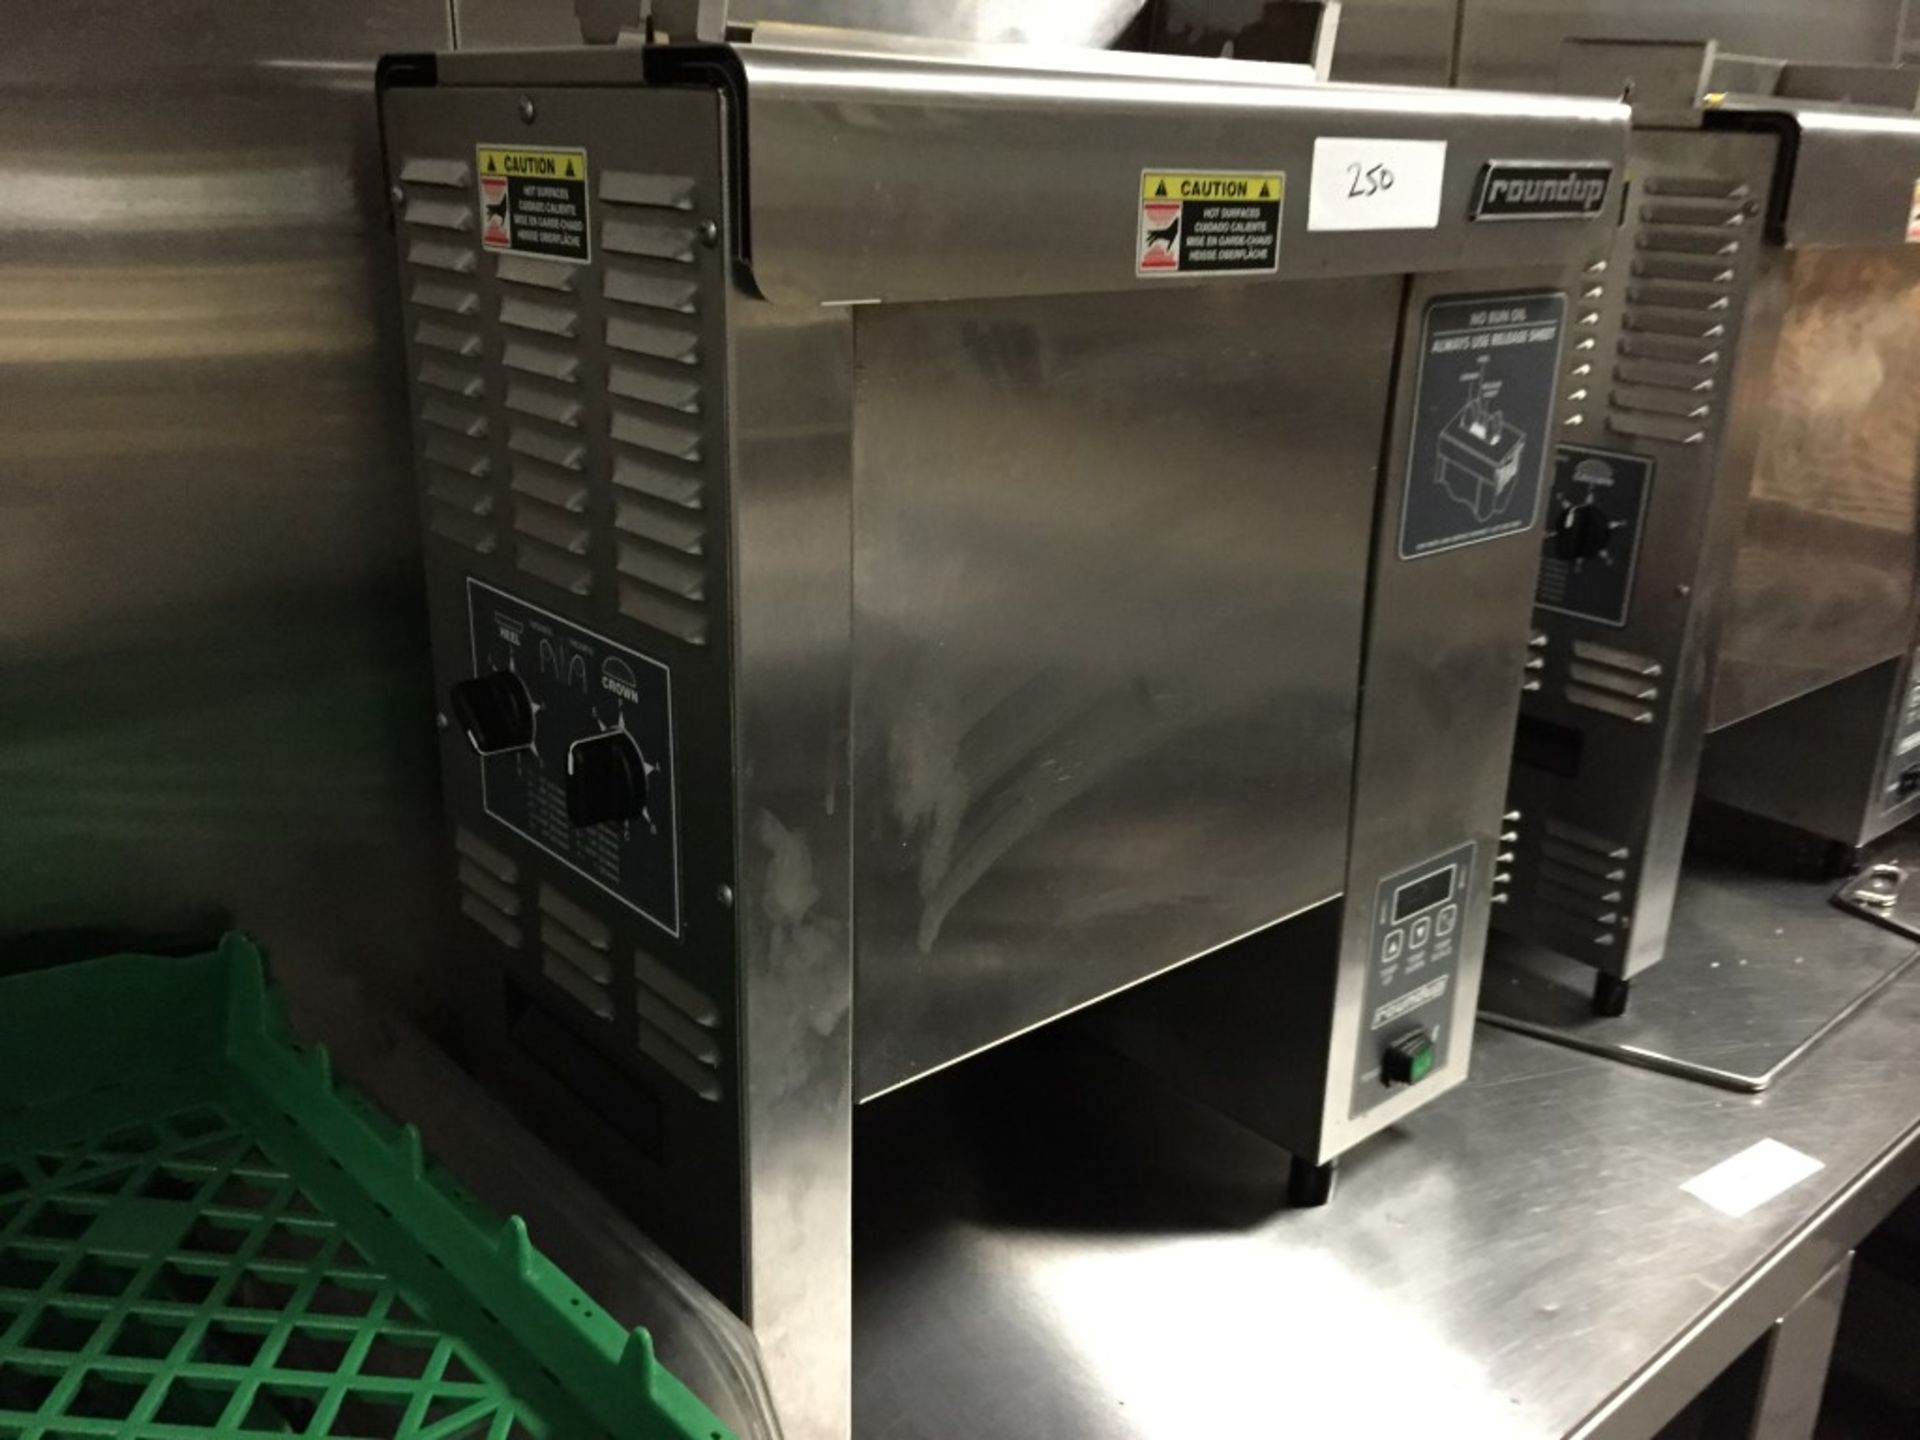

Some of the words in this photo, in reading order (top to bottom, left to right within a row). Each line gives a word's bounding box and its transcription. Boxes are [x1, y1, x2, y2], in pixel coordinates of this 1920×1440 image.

[504, 155, 555, 175] CAUTION
[1180, 180, 1248, 197] CAUTION
[1347, 162, 1395, 199] 250
[1488, 171, 1605, 210] roundup
[1203, 208, 1220, 219] HOT
[601, 675, 639, 704] CROWN
